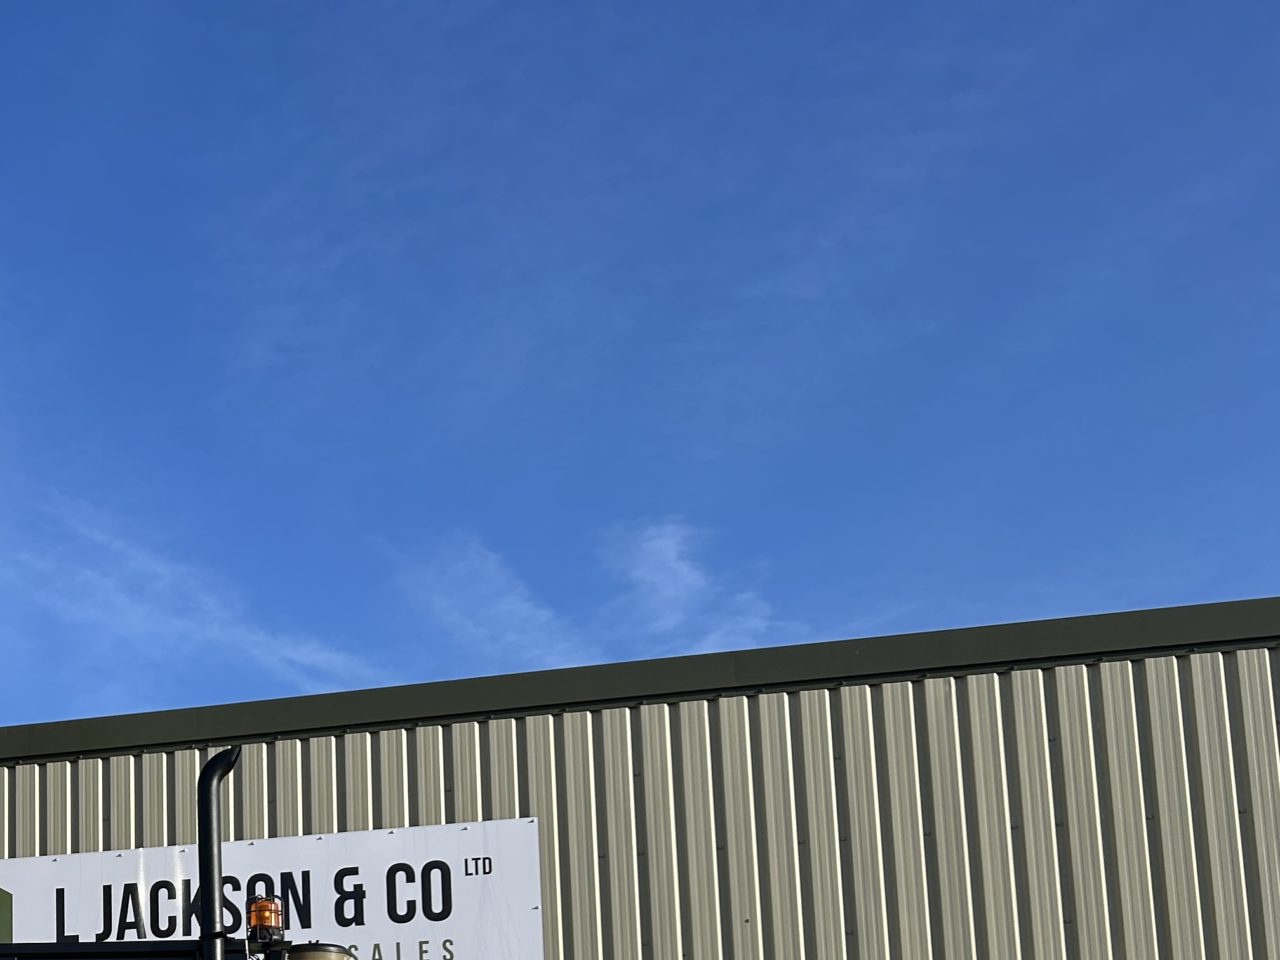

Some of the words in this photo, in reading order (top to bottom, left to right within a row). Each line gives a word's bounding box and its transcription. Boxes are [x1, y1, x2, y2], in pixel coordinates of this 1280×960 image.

[56, 888, 80, 943] L
[333, 866, 367, 928] &
[386, 860, 453, 924] CO
[464, 857, 493, 876] LTD
